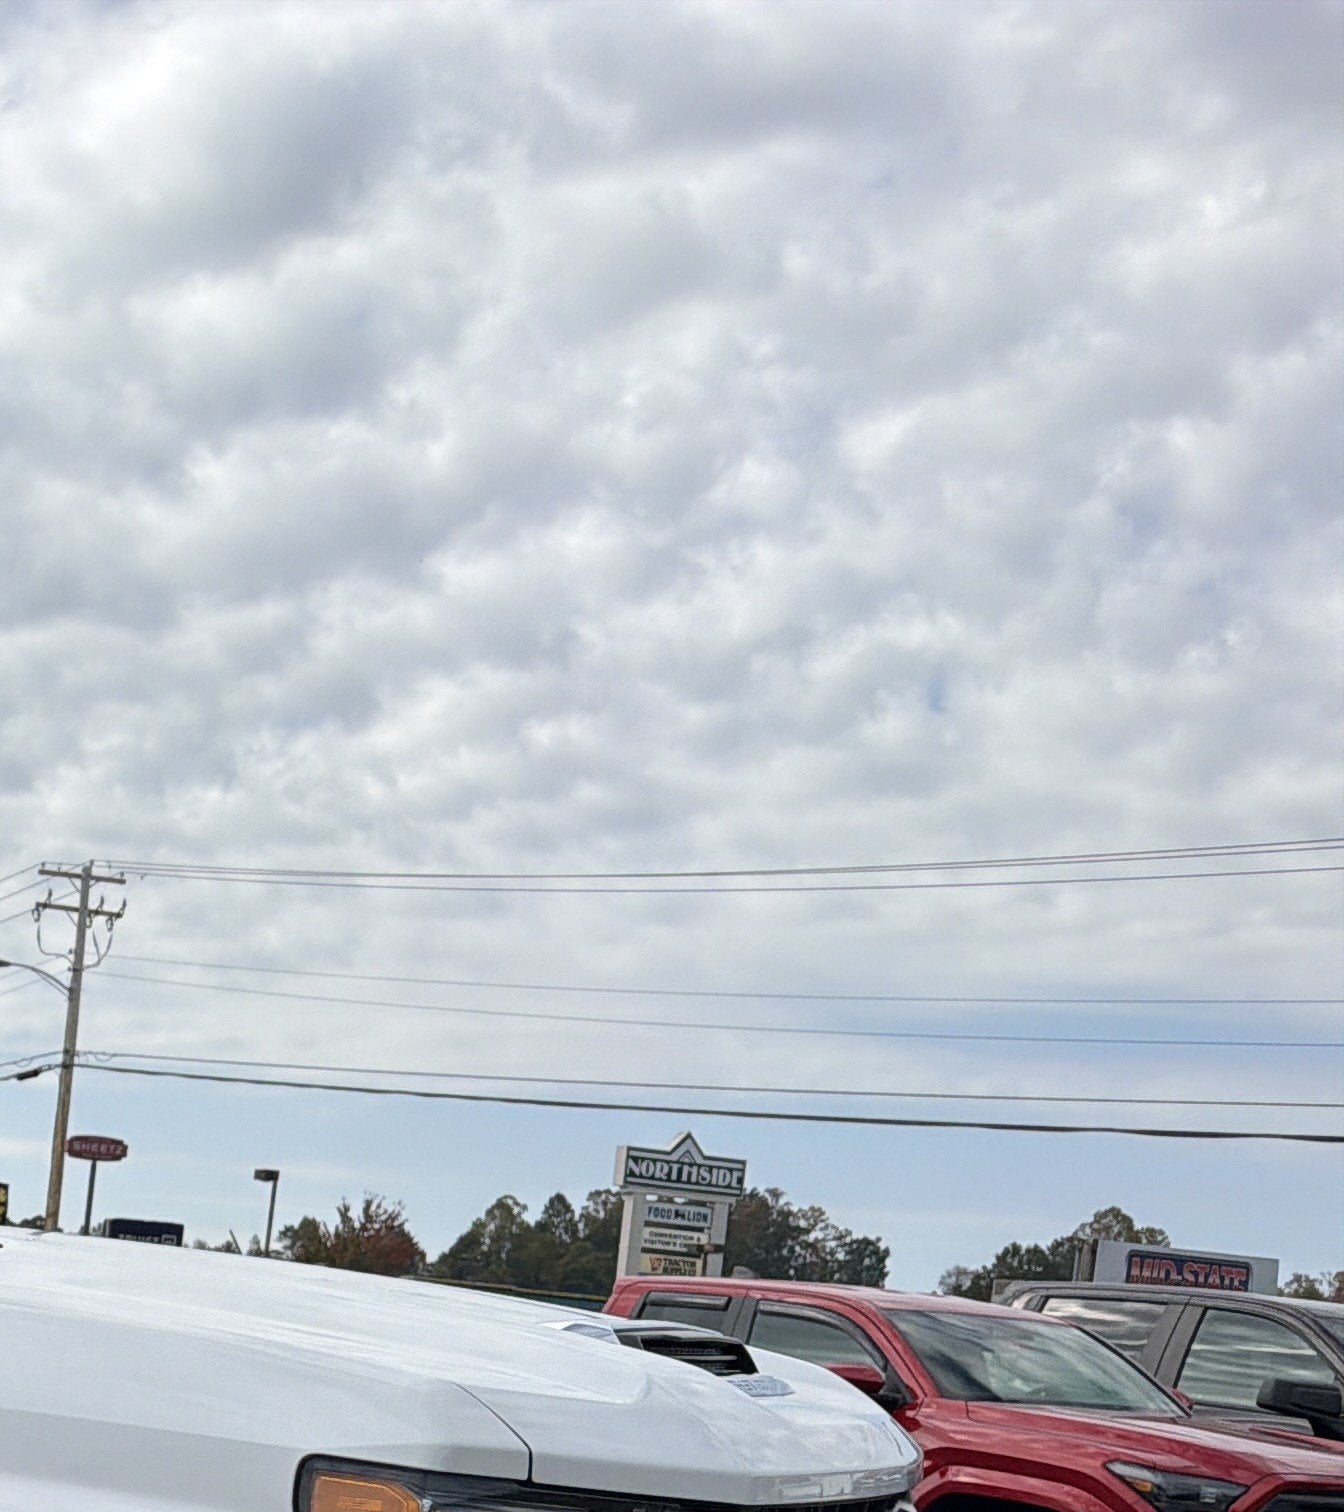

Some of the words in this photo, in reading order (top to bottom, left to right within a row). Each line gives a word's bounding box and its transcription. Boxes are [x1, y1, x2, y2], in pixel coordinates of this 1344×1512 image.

[73, 1141, 123, 1154] SHEETZ
[626, 1158, 743, 1188] NORTHSIDE
[647, 1206, 672, 1220] FOOD
[687, 1210, 709, 1223] LION
[1130, 1256, 1249, 1292] MID-STATE
